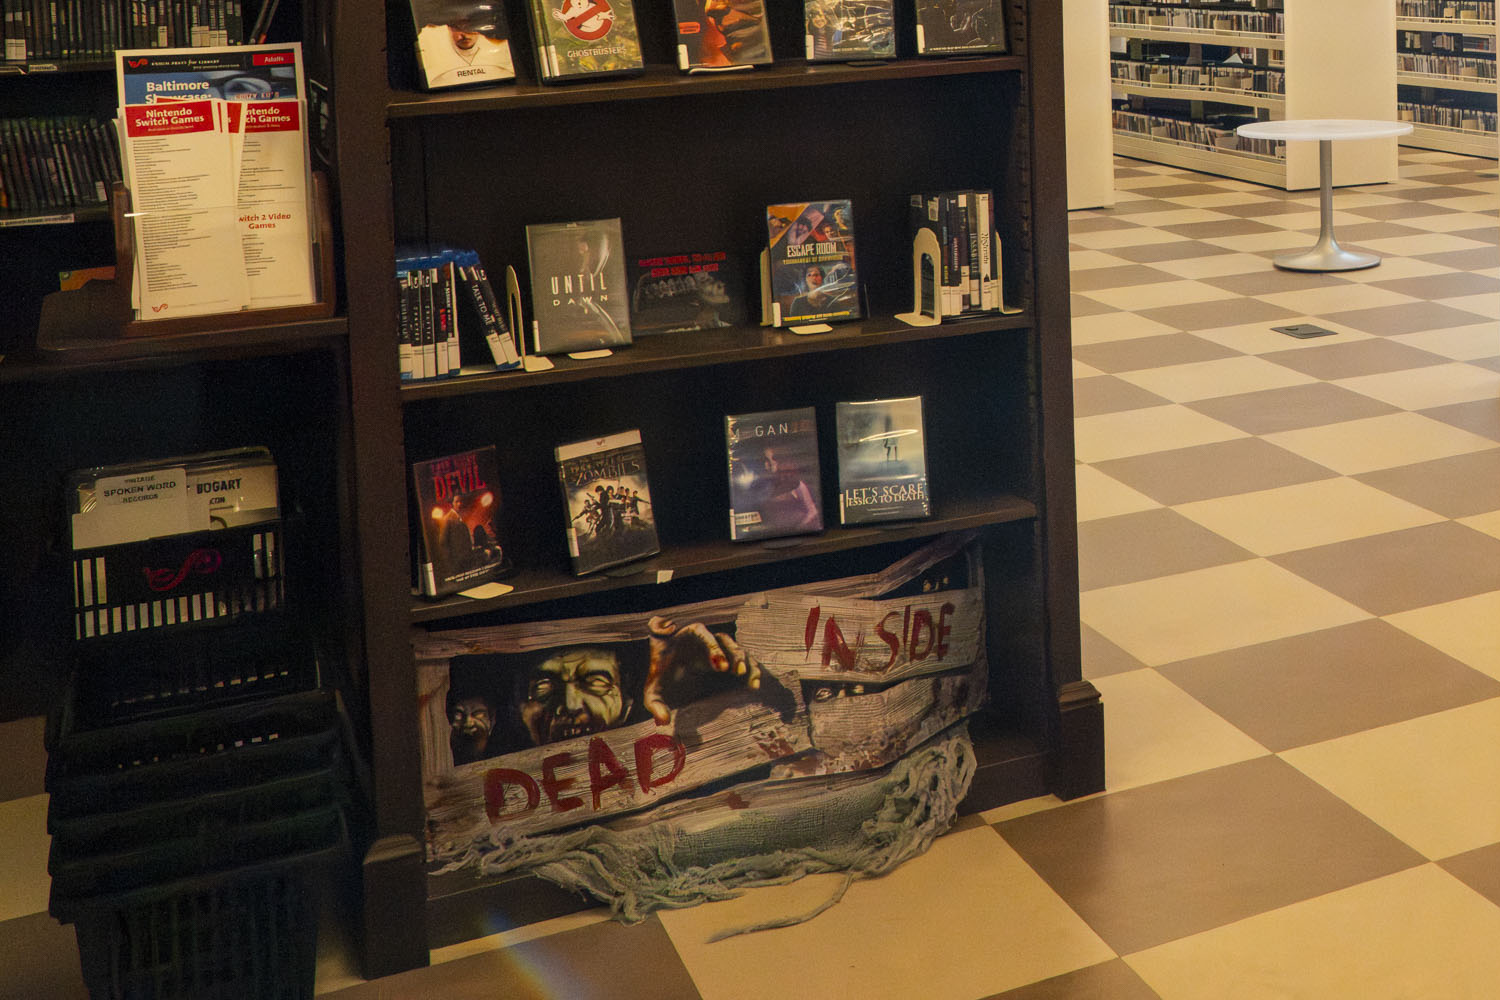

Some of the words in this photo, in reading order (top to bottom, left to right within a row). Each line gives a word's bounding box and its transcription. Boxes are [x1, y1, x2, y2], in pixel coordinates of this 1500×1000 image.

[567, 47, 628, 59] GHOSTBUSTERS
[457, 68, 486, 78] RENTAL
[146, 81, 210, 93] Baltimore
[146, 108, 192, 118] Nintendo
[246, 106, 280, 116] ntendo
[135, 117, 169, 128] Switch
[170, 114, 205, 125] Games
[259, 114, 291, 123] Games
[238, 213, 260, 223] witch
[268, 213, 291, 221] Video
[248, 222, 276, 230] Games
[787, 243, 815, 257] ESCAPE
[816, 242, 837, 255] ROOM
[551, 272, 608, 295] UNTIL
[471, 285, 482, 301] TALK
[478, 301, 488, 314] TO
[552, 294, 608, 306] DAWN
[103, 486, 144, 497] SPOKEN
[147, 481, 177, 492] WORD
[196, 478, 242, 495] BOGART
[434, 466, 487, 500] DEVIL
[846, 487, 878, 500] LET'S
[883, 483, 924, 496] SCARE
[846, 497, 878, 507] JESSICA
[879, 495, 892, 504] TO
[893, 492, 924, 503] DEATH
[805, 601, 955, 672] INSIDE
[485, 733, 686, 825] DEAD
